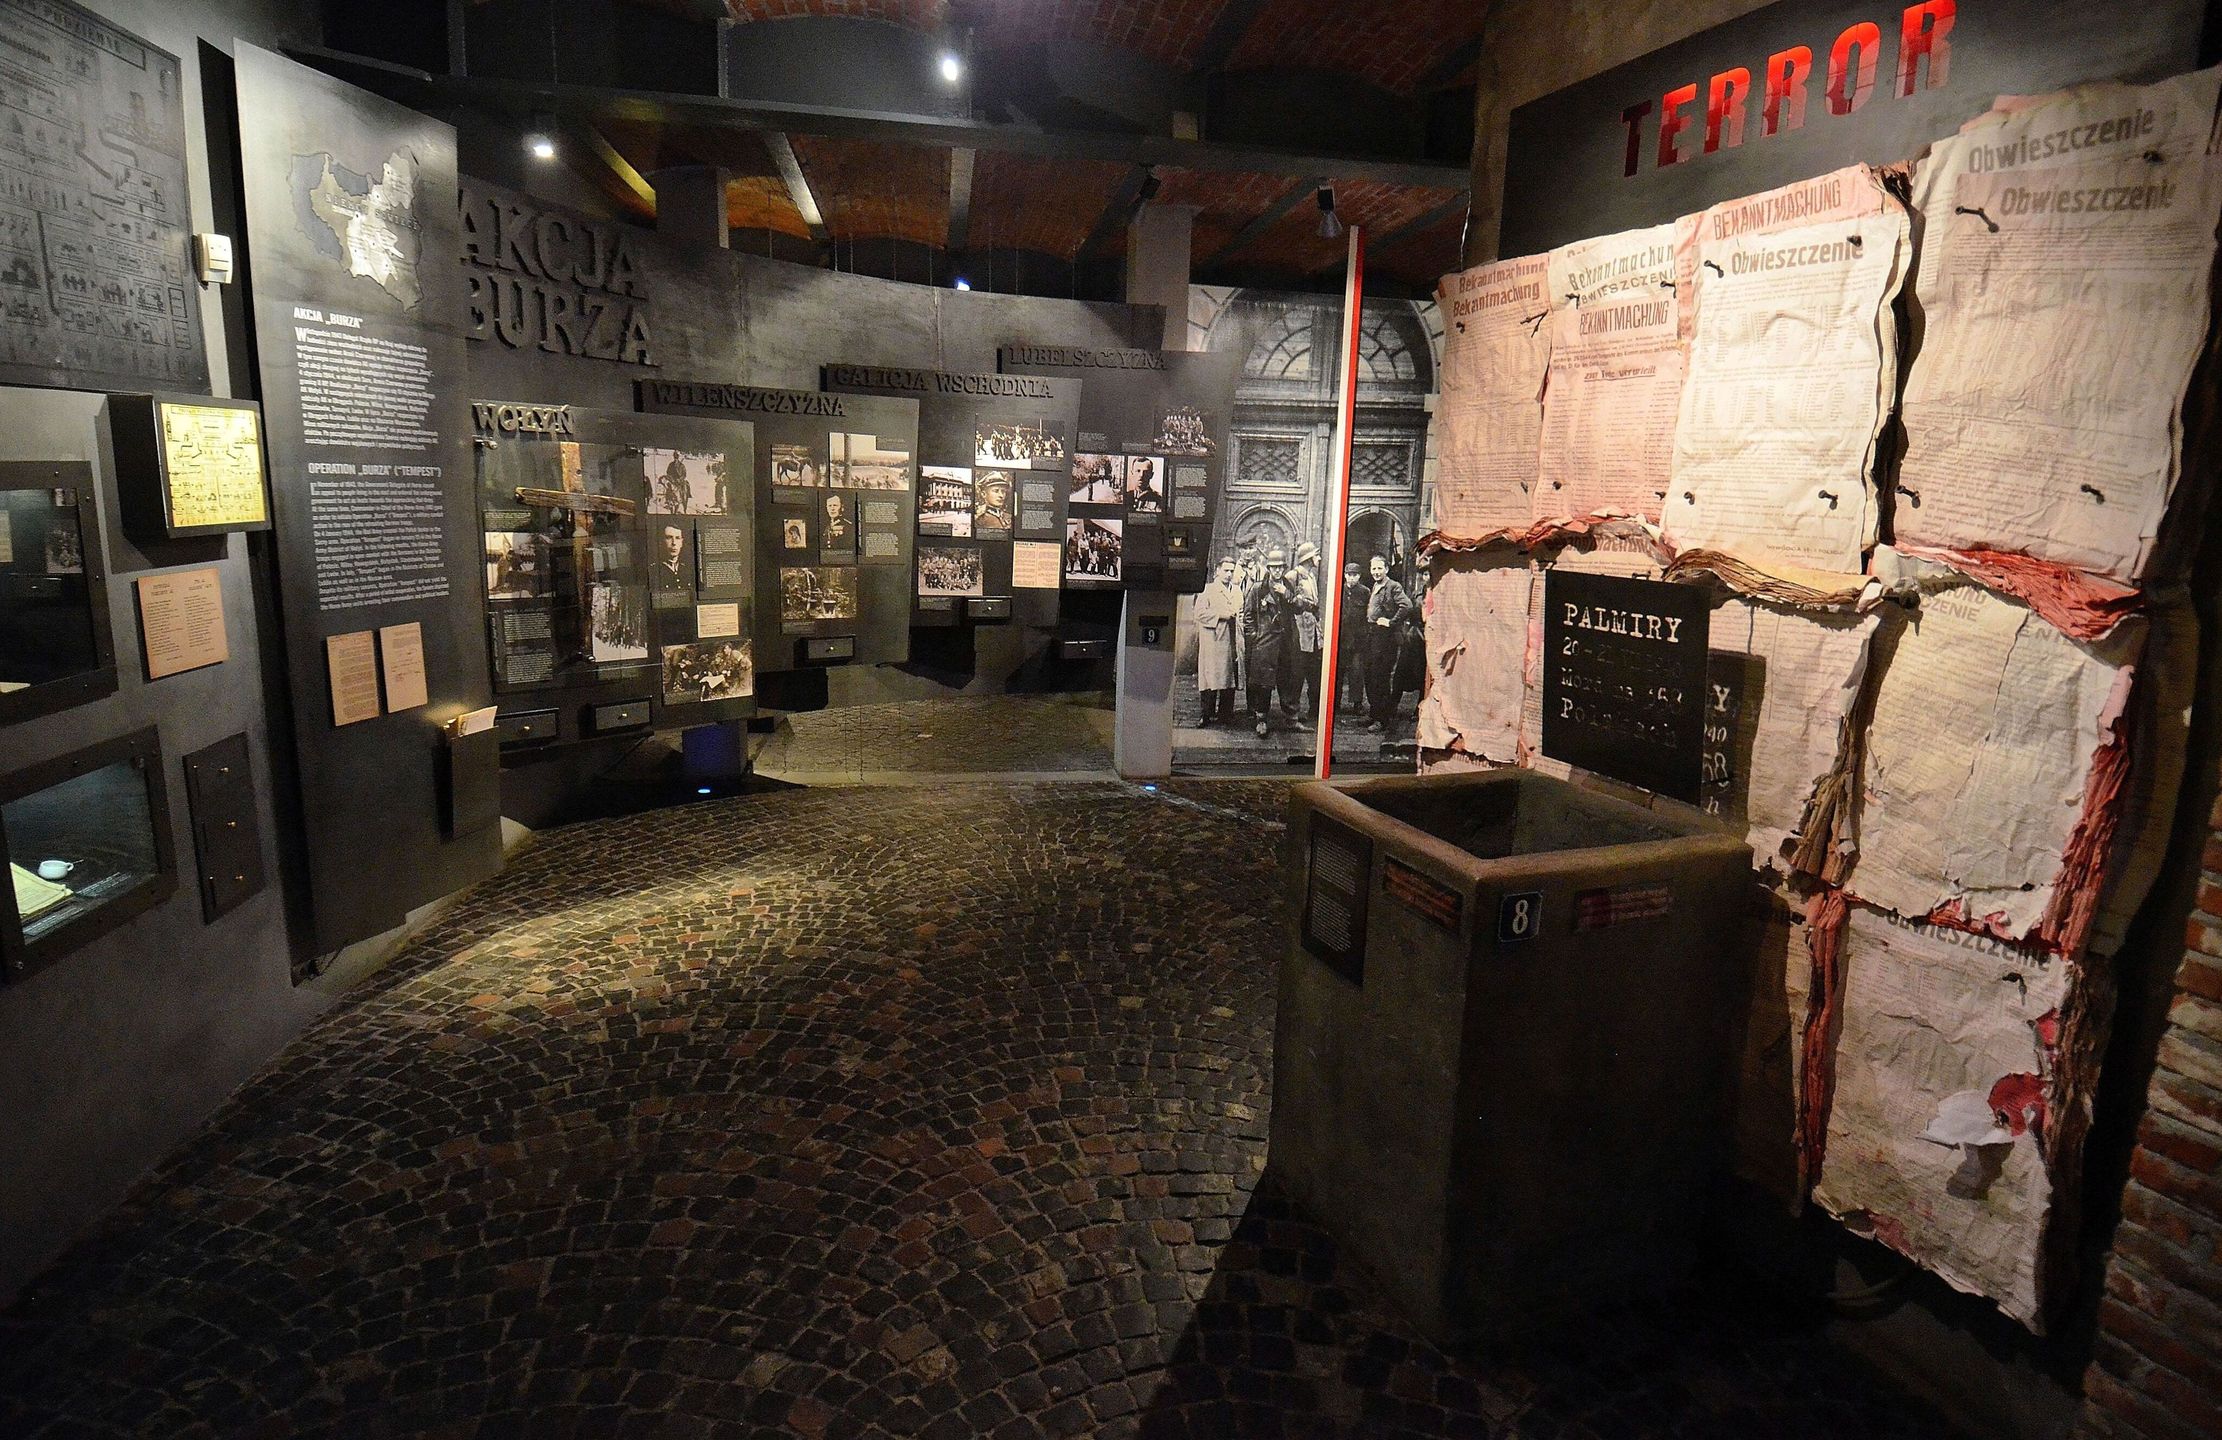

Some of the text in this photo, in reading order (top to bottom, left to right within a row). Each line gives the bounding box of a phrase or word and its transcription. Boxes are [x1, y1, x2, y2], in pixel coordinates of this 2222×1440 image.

[1619, 0, 1957, 178] TERROR
[1968, 108, 2155, 174] Obwieszczenie
[1713, 179, 1842, 241] BEKANNTMACHUNG
[456, 187, 650, 300] AKCJA
[1732, 241, 1864, 276] Obwieszczenie
[1568, 244, 1674, 291] Bekanntmachun
[294, 307, 324, 323] AKCJA
[462, 270, 662, 368] BURZA
[1009, 347, 1168, 371] LUBELSZCZYZNA
[935, 372, 1054, 398] WSCHODNIA
[471, 403, 575, 434] WOŁYŃ
[308, 463, 356, 475] OPERATION
[1148, 629, 1155, 643] 9
[1563, 602, 1682, 643] PALMIRY
[1512, 899, 1529, 935] 8
